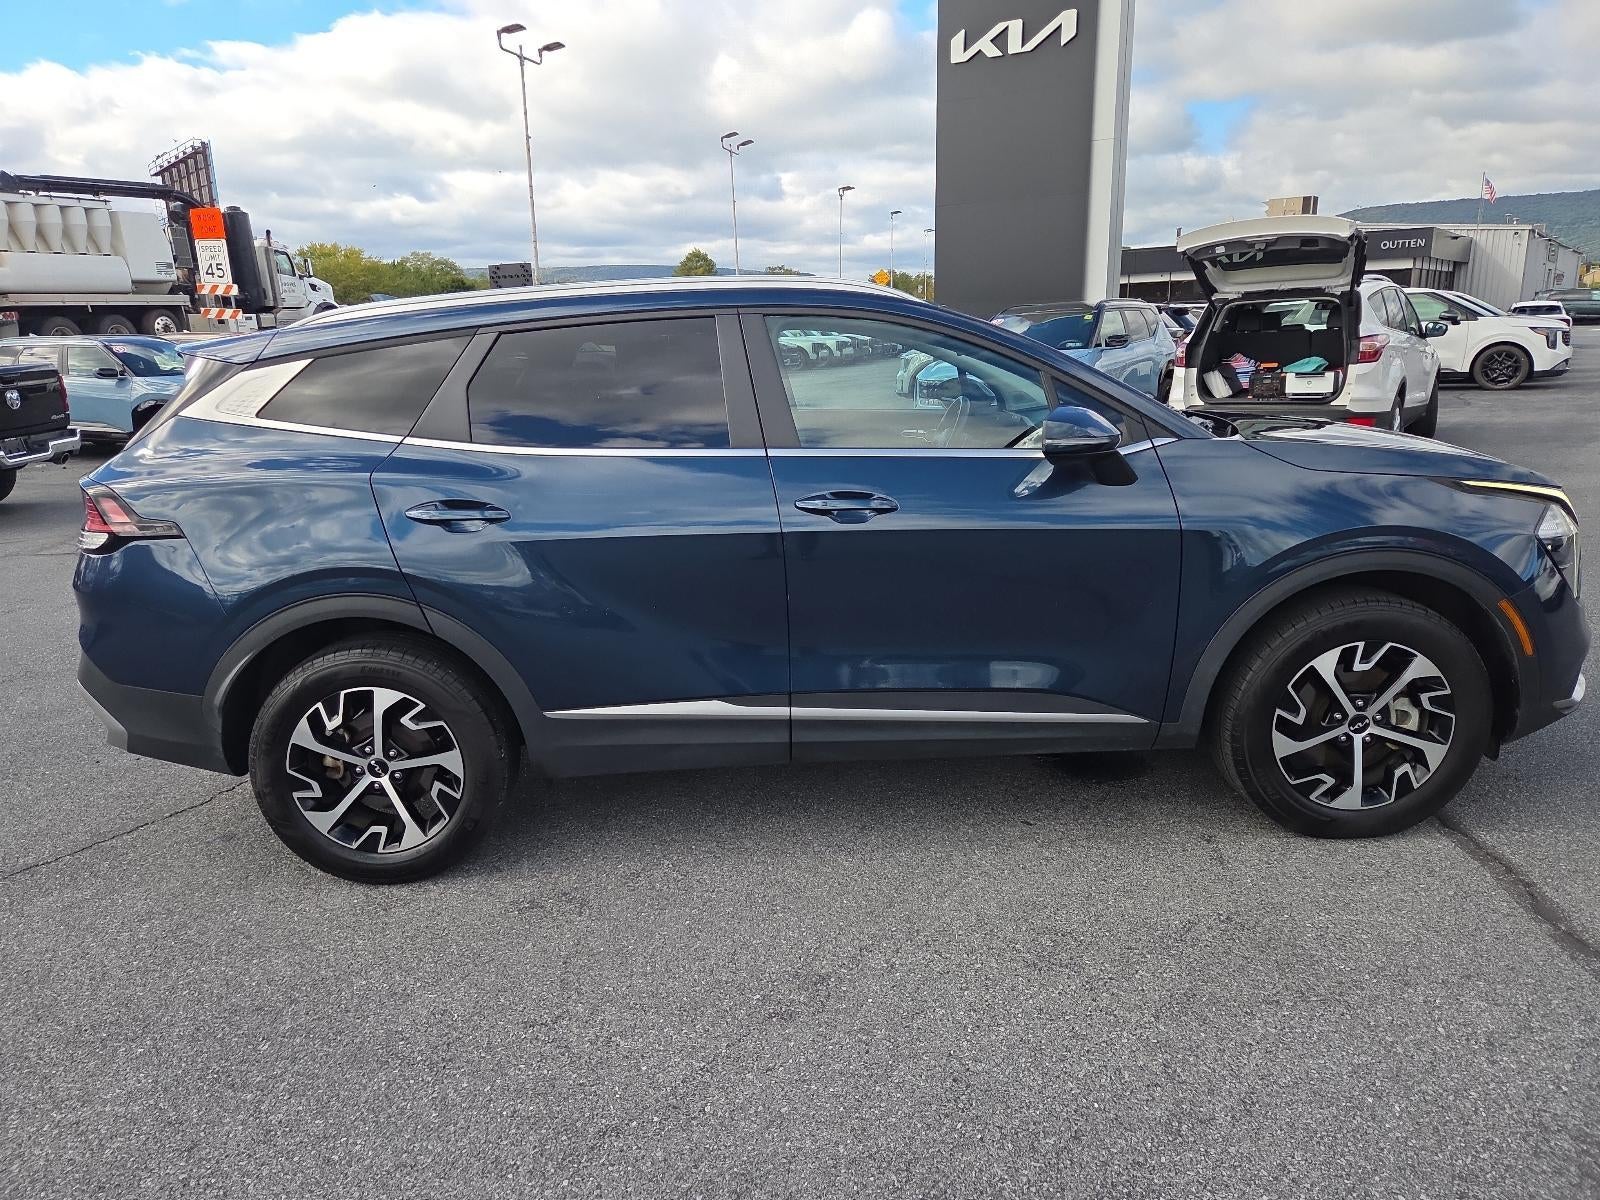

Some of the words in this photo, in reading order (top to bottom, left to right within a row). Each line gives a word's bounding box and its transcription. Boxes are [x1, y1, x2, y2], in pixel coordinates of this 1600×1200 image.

[951, 8, 1078, 64] KIA
[197, 214, 216, 222] WORK
[200, 226, 218, 234] ZONE
[1380, 238, 1426, 250] OUTTEN
[201, 245, 222, 253] SPEED
[204, 254, 221, 262] LIMIT
[205, 263, 225, 279] 45
